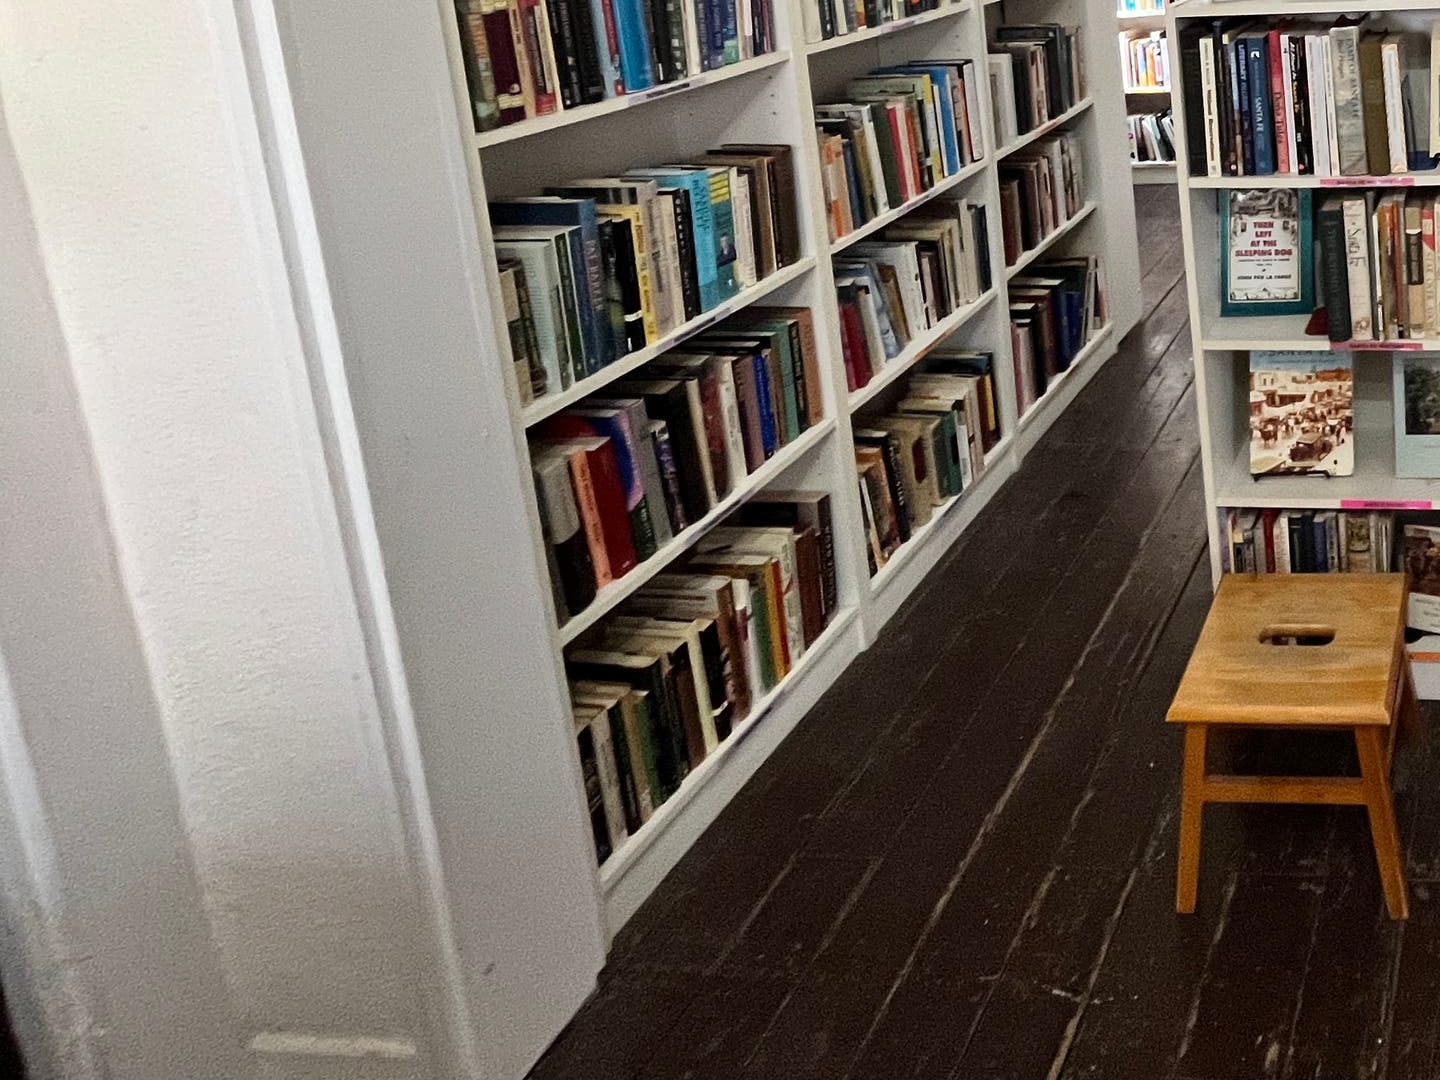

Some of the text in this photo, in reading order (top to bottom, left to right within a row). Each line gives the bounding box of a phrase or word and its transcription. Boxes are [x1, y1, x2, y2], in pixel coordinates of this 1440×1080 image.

[1255, 96, 1264, 132] SANTA FE
[1235, 249, 1272, 257] SLEEPING
